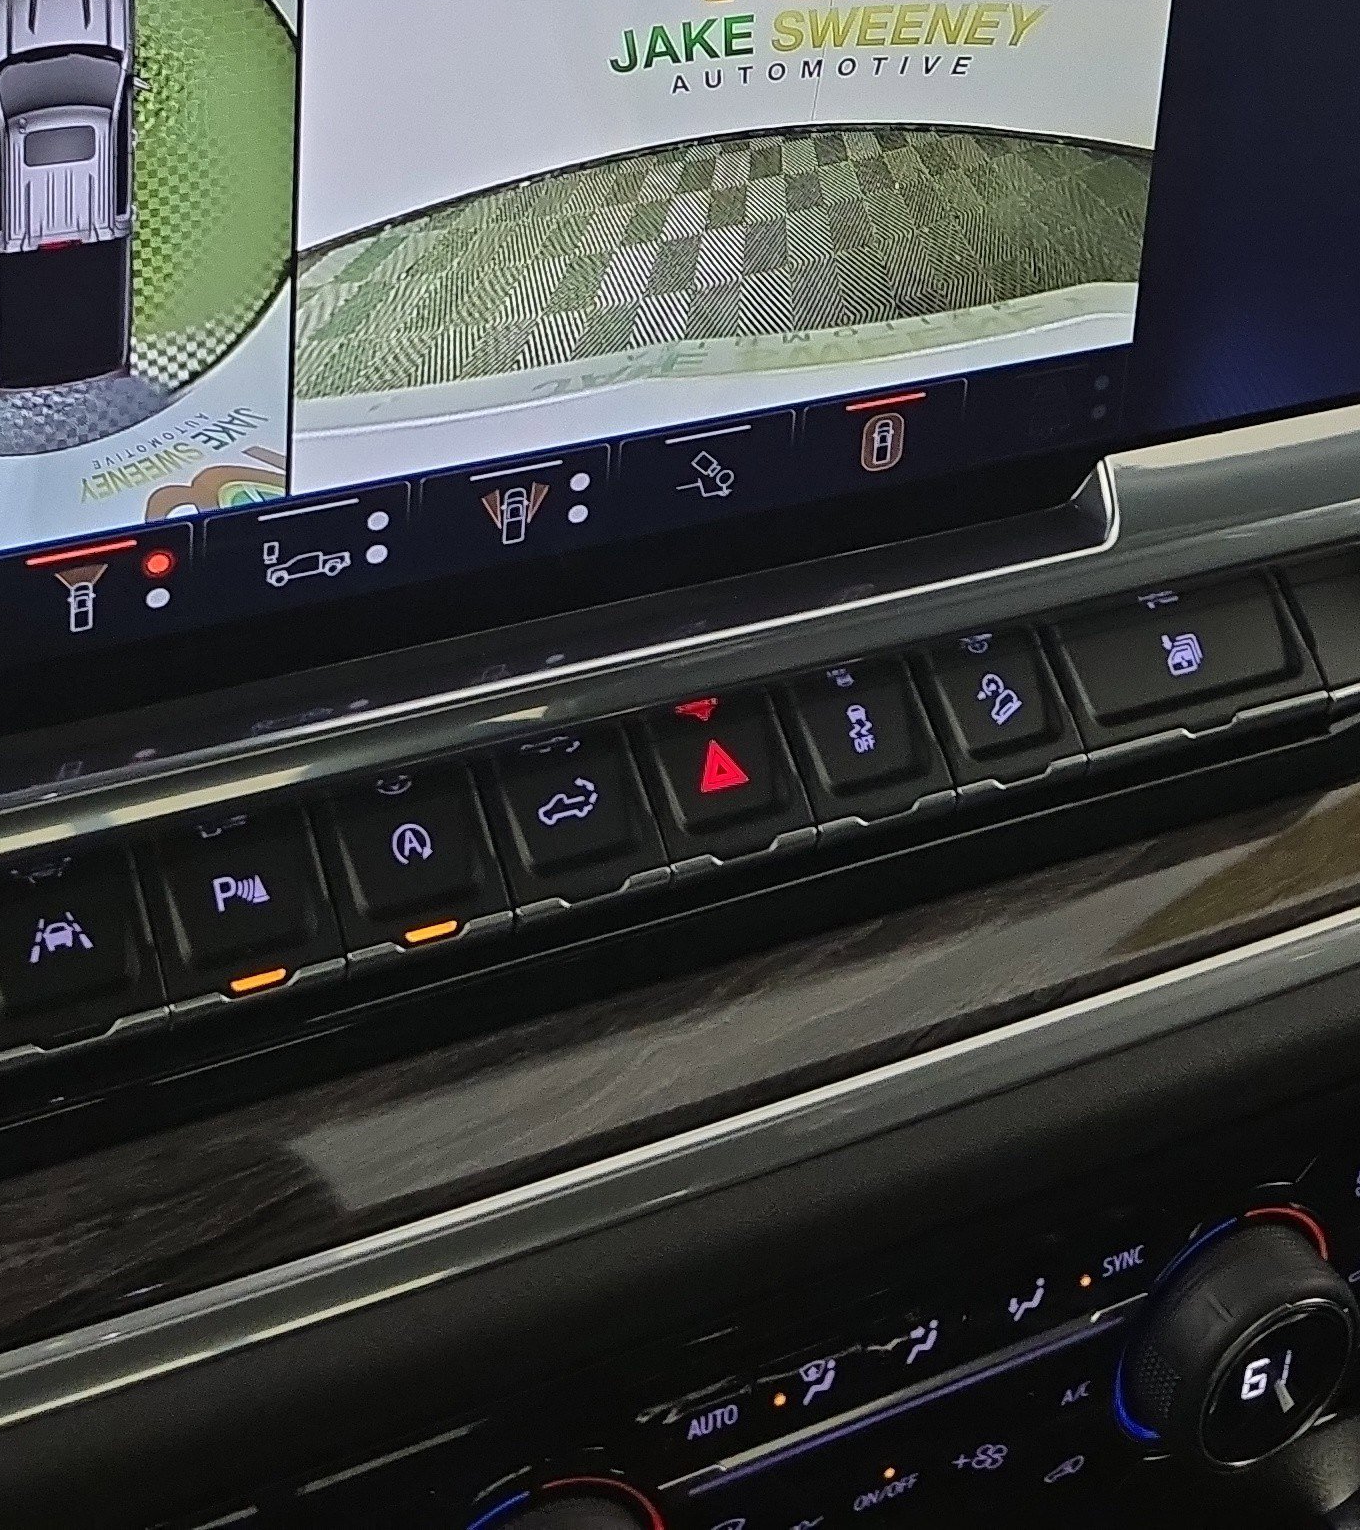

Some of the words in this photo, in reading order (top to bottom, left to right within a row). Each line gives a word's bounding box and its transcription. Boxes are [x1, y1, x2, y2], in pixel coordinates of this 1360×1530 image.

[608, 14, 756, 74] JAKE
[771, 3, 1049, 53] SWEENEY
[671, 55, 973, 94] AUTOMOTIVE
[93, 412, 210, 470] AUTOMOTIVE
[190, 407, 270, 451] JAKE
[79, 441, 204, 505] SWEENEY
[1102, 1244, 1145, 1278] SYNC
[687, 1404, 739, 1441] AUTO
[853, 1472, 919, 1512] ON/OFF
